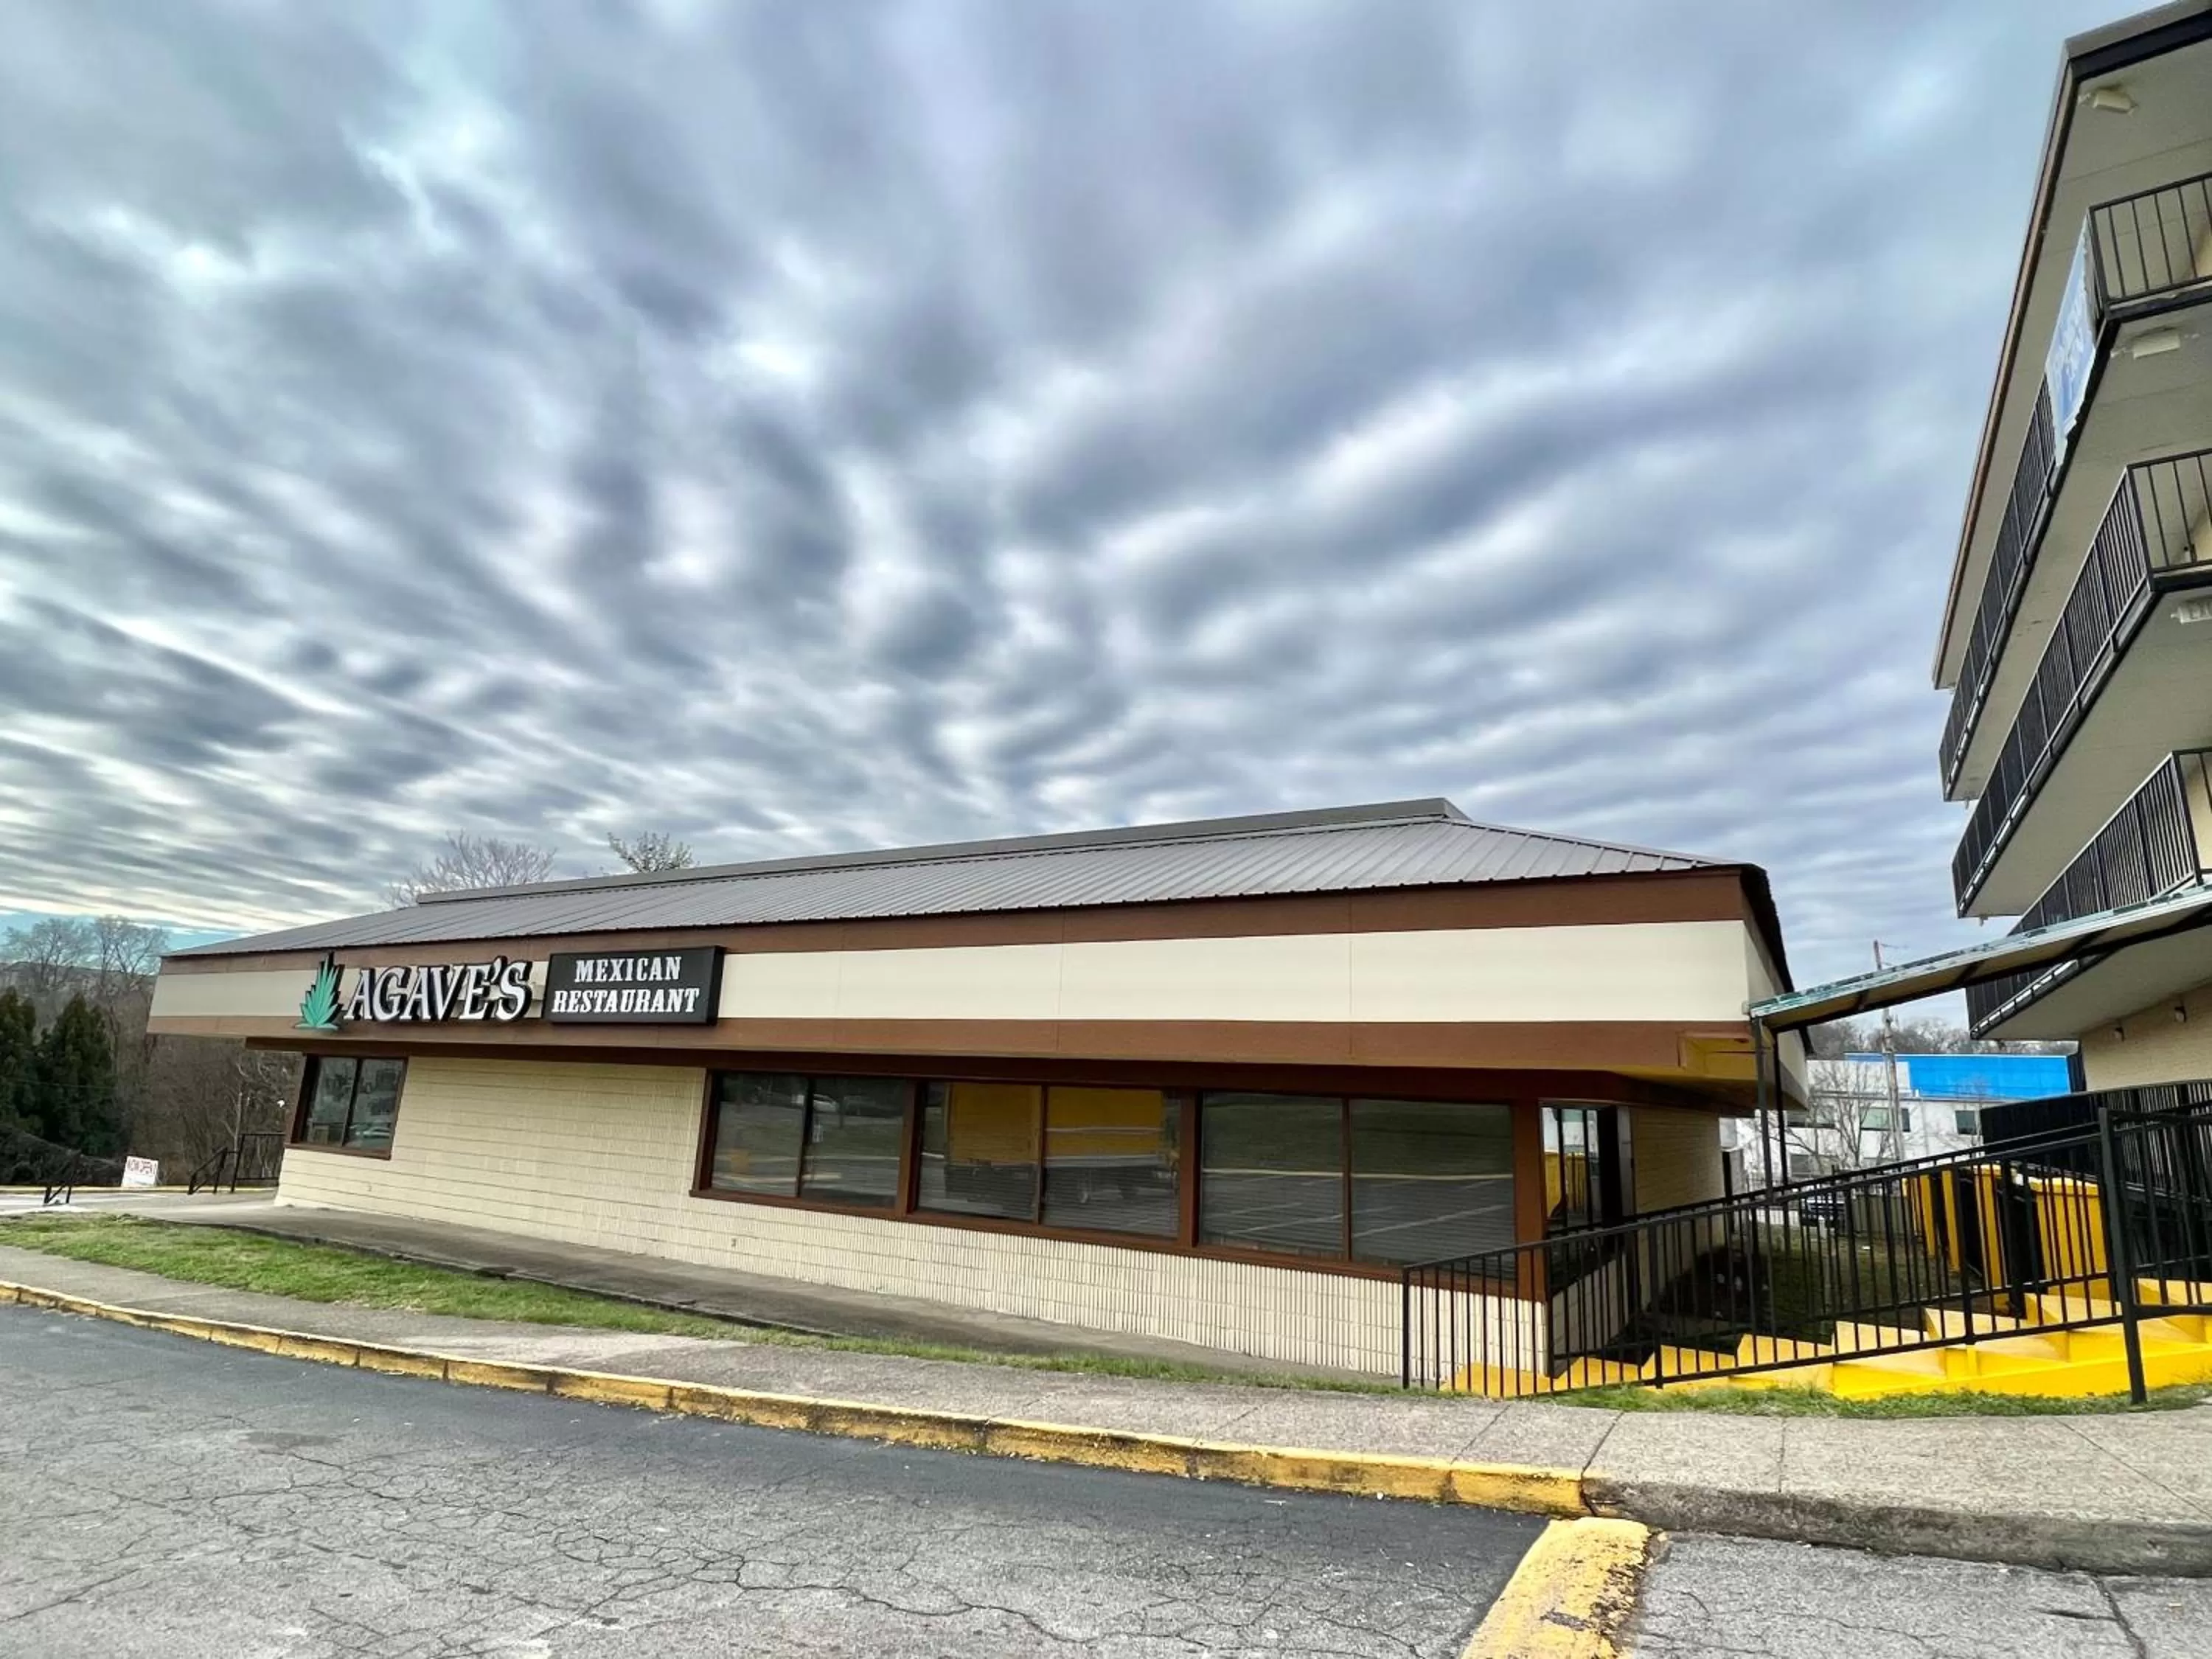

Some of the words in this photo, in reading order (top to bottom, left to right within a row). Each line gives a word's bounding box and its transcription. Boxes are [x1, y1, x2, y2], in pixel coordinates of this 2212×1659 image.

[574, 956, 682, 983] MEXICAN
[343, 956, 531, 1022] AGAVE'S
[551, 987, 700, 1013] RESTAURANT
